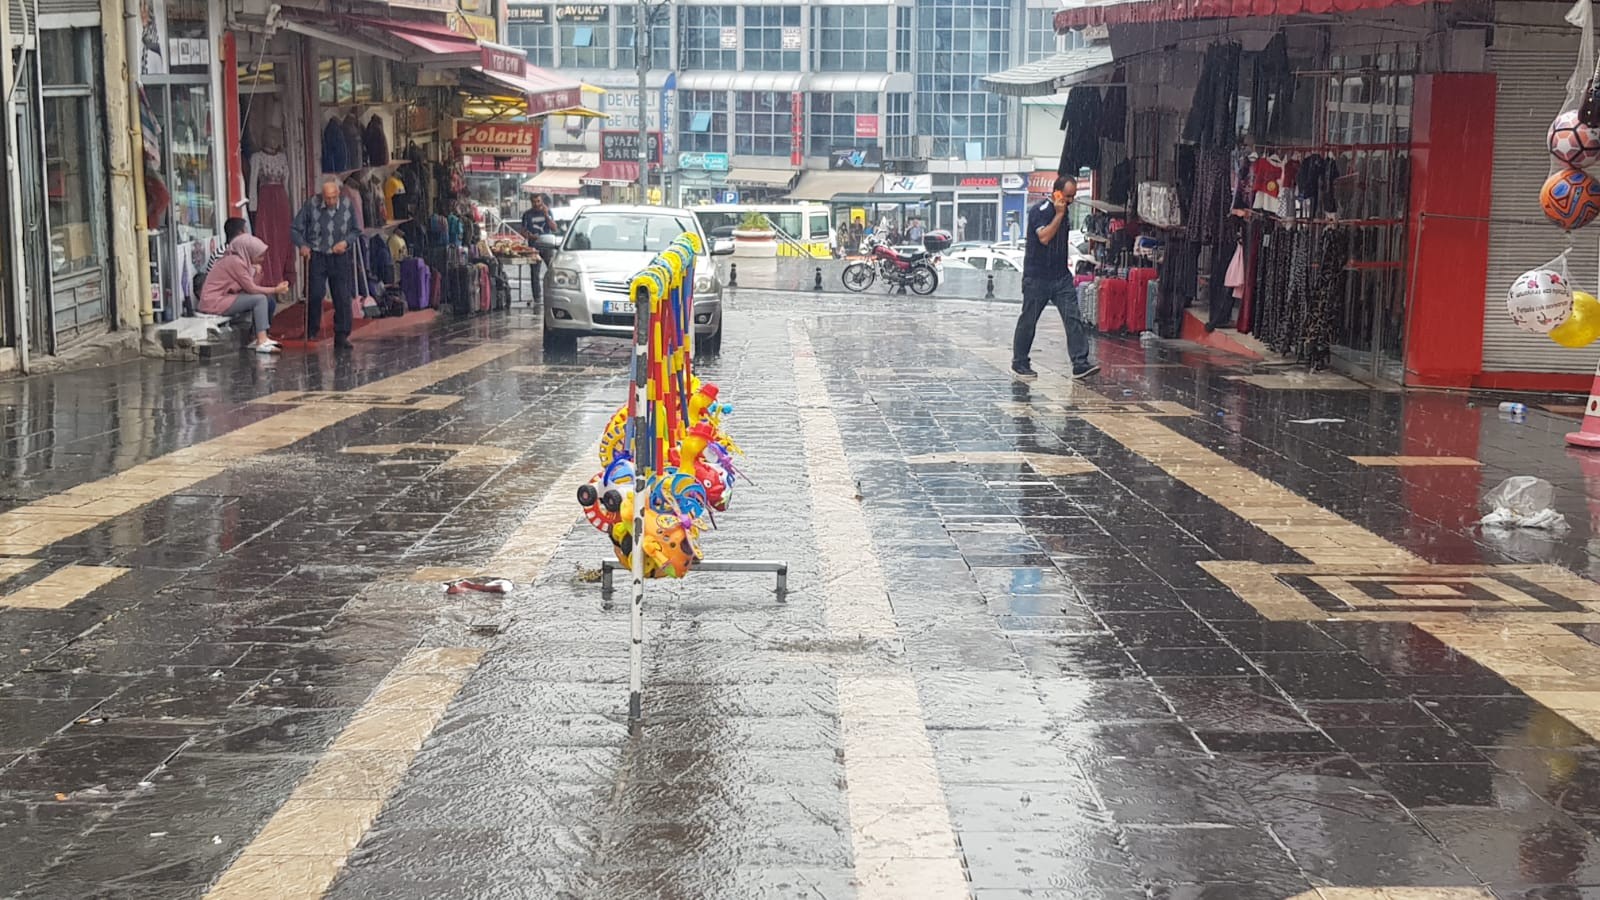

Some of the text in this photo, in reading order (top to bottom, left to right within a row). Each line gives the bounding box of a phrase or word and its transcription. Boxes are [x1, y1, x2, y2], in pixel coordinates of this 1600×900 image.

[565, 5, 607, 15] AVUKAT
[462, 125, 533, 145] Polaris
[607, 149, 653, 160] SARRF
[726, 194, 734, 203] P
